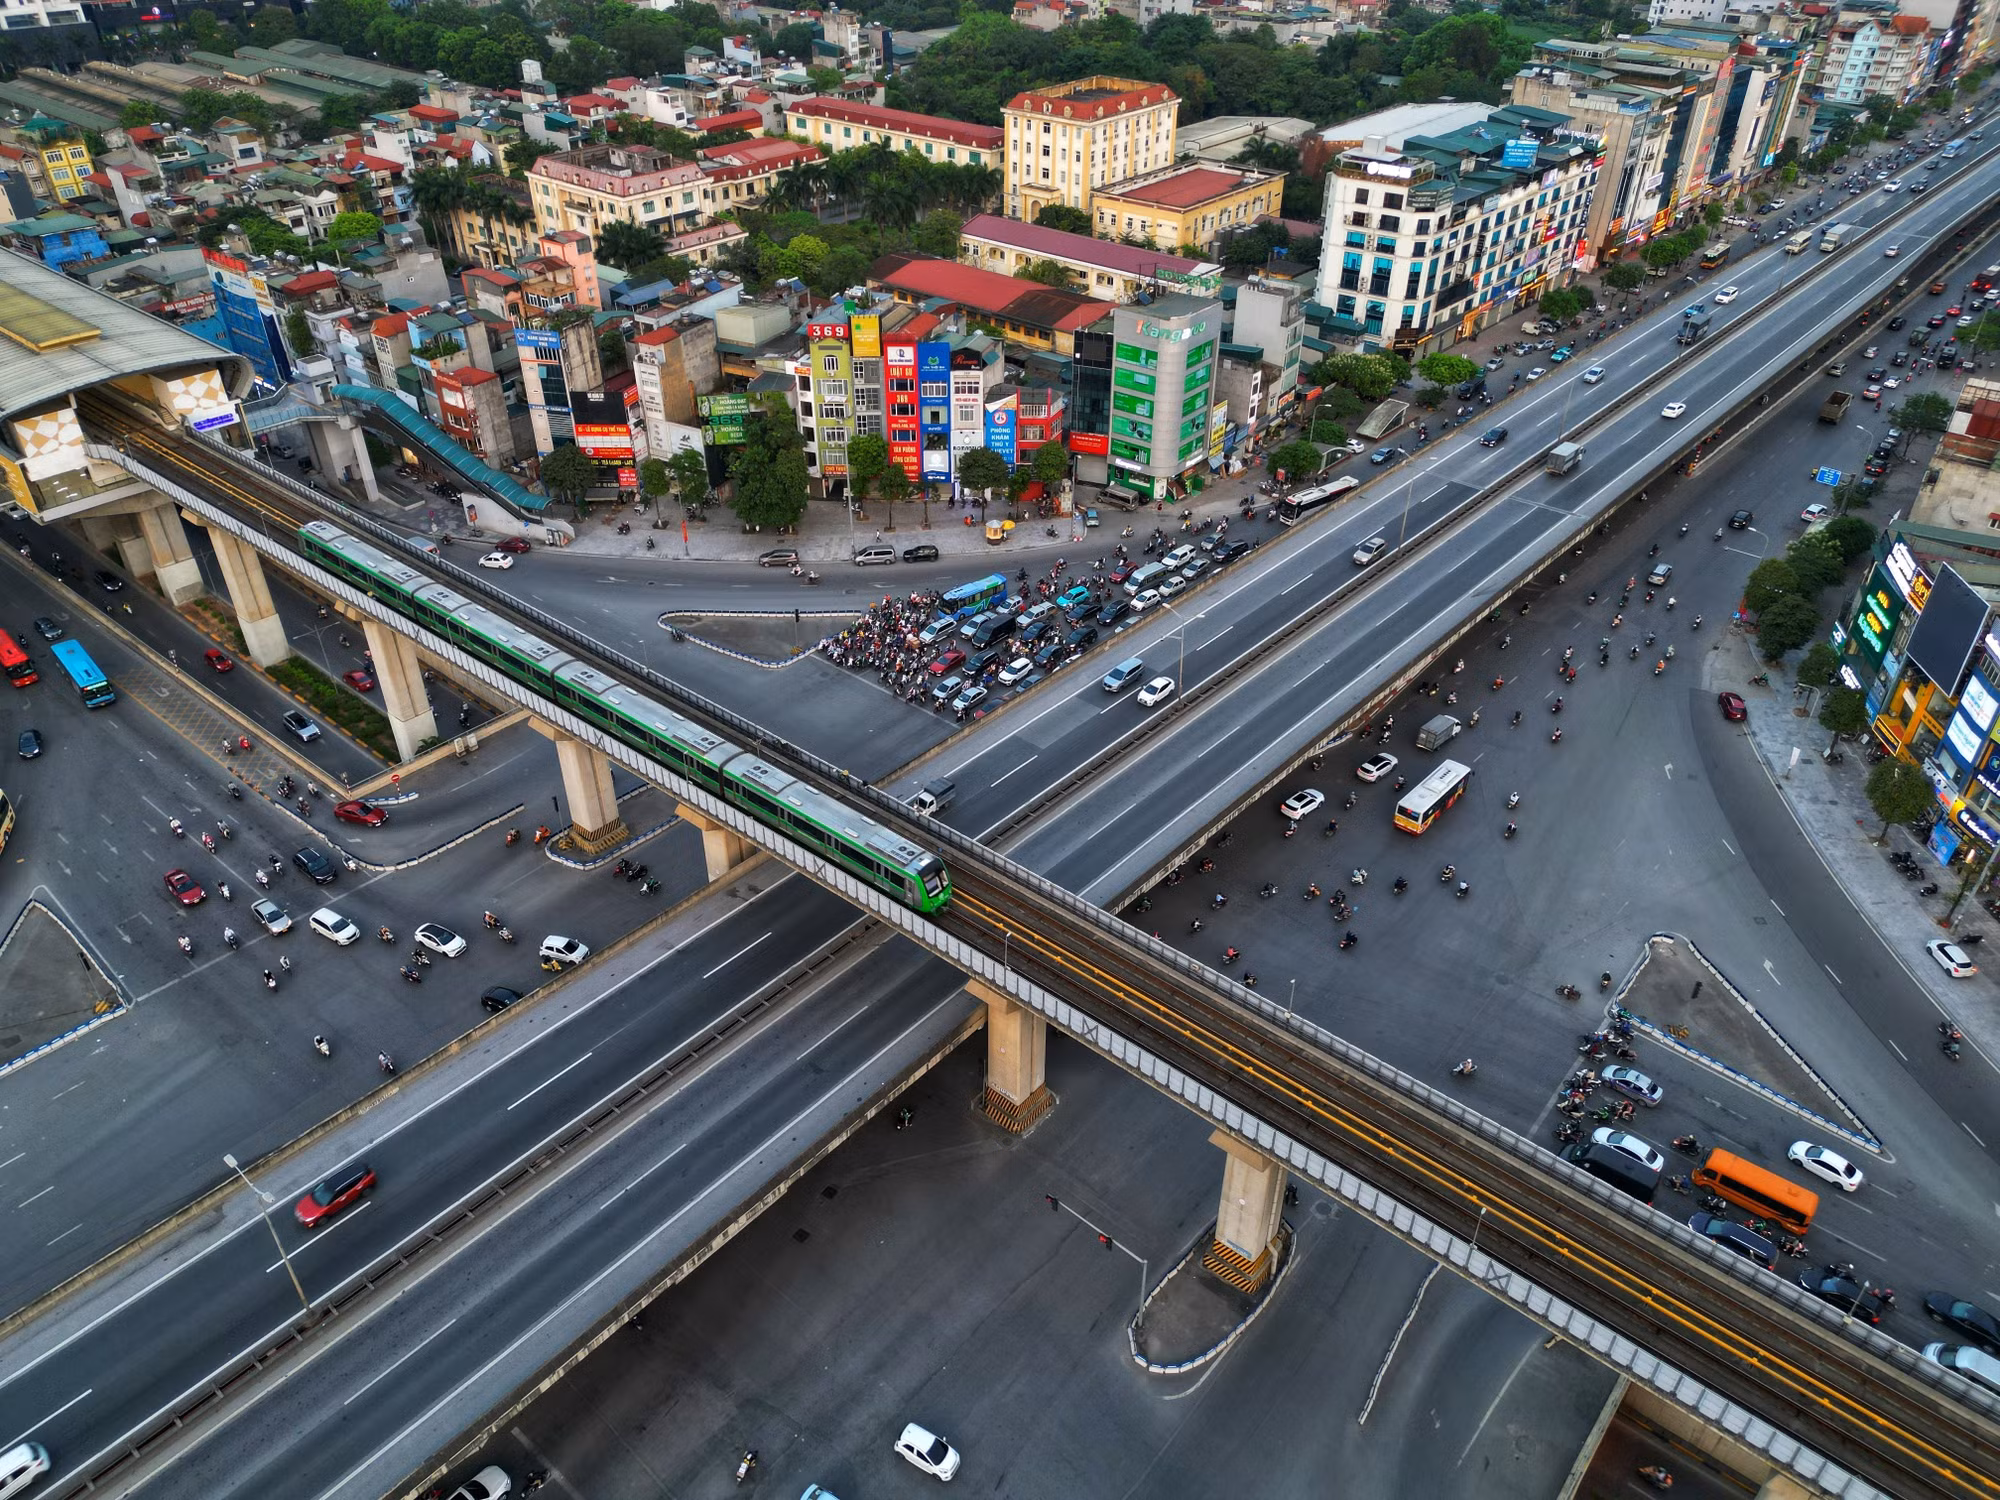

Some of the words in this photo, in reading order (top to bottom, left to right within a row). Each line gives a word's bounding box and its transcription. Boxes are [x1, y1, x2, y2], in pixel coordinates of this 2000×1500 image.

[813, 325, 844, 337] 369
[1136, 320, 1206, 344] Kangaroo
[708, 415, 743, 425] 363
